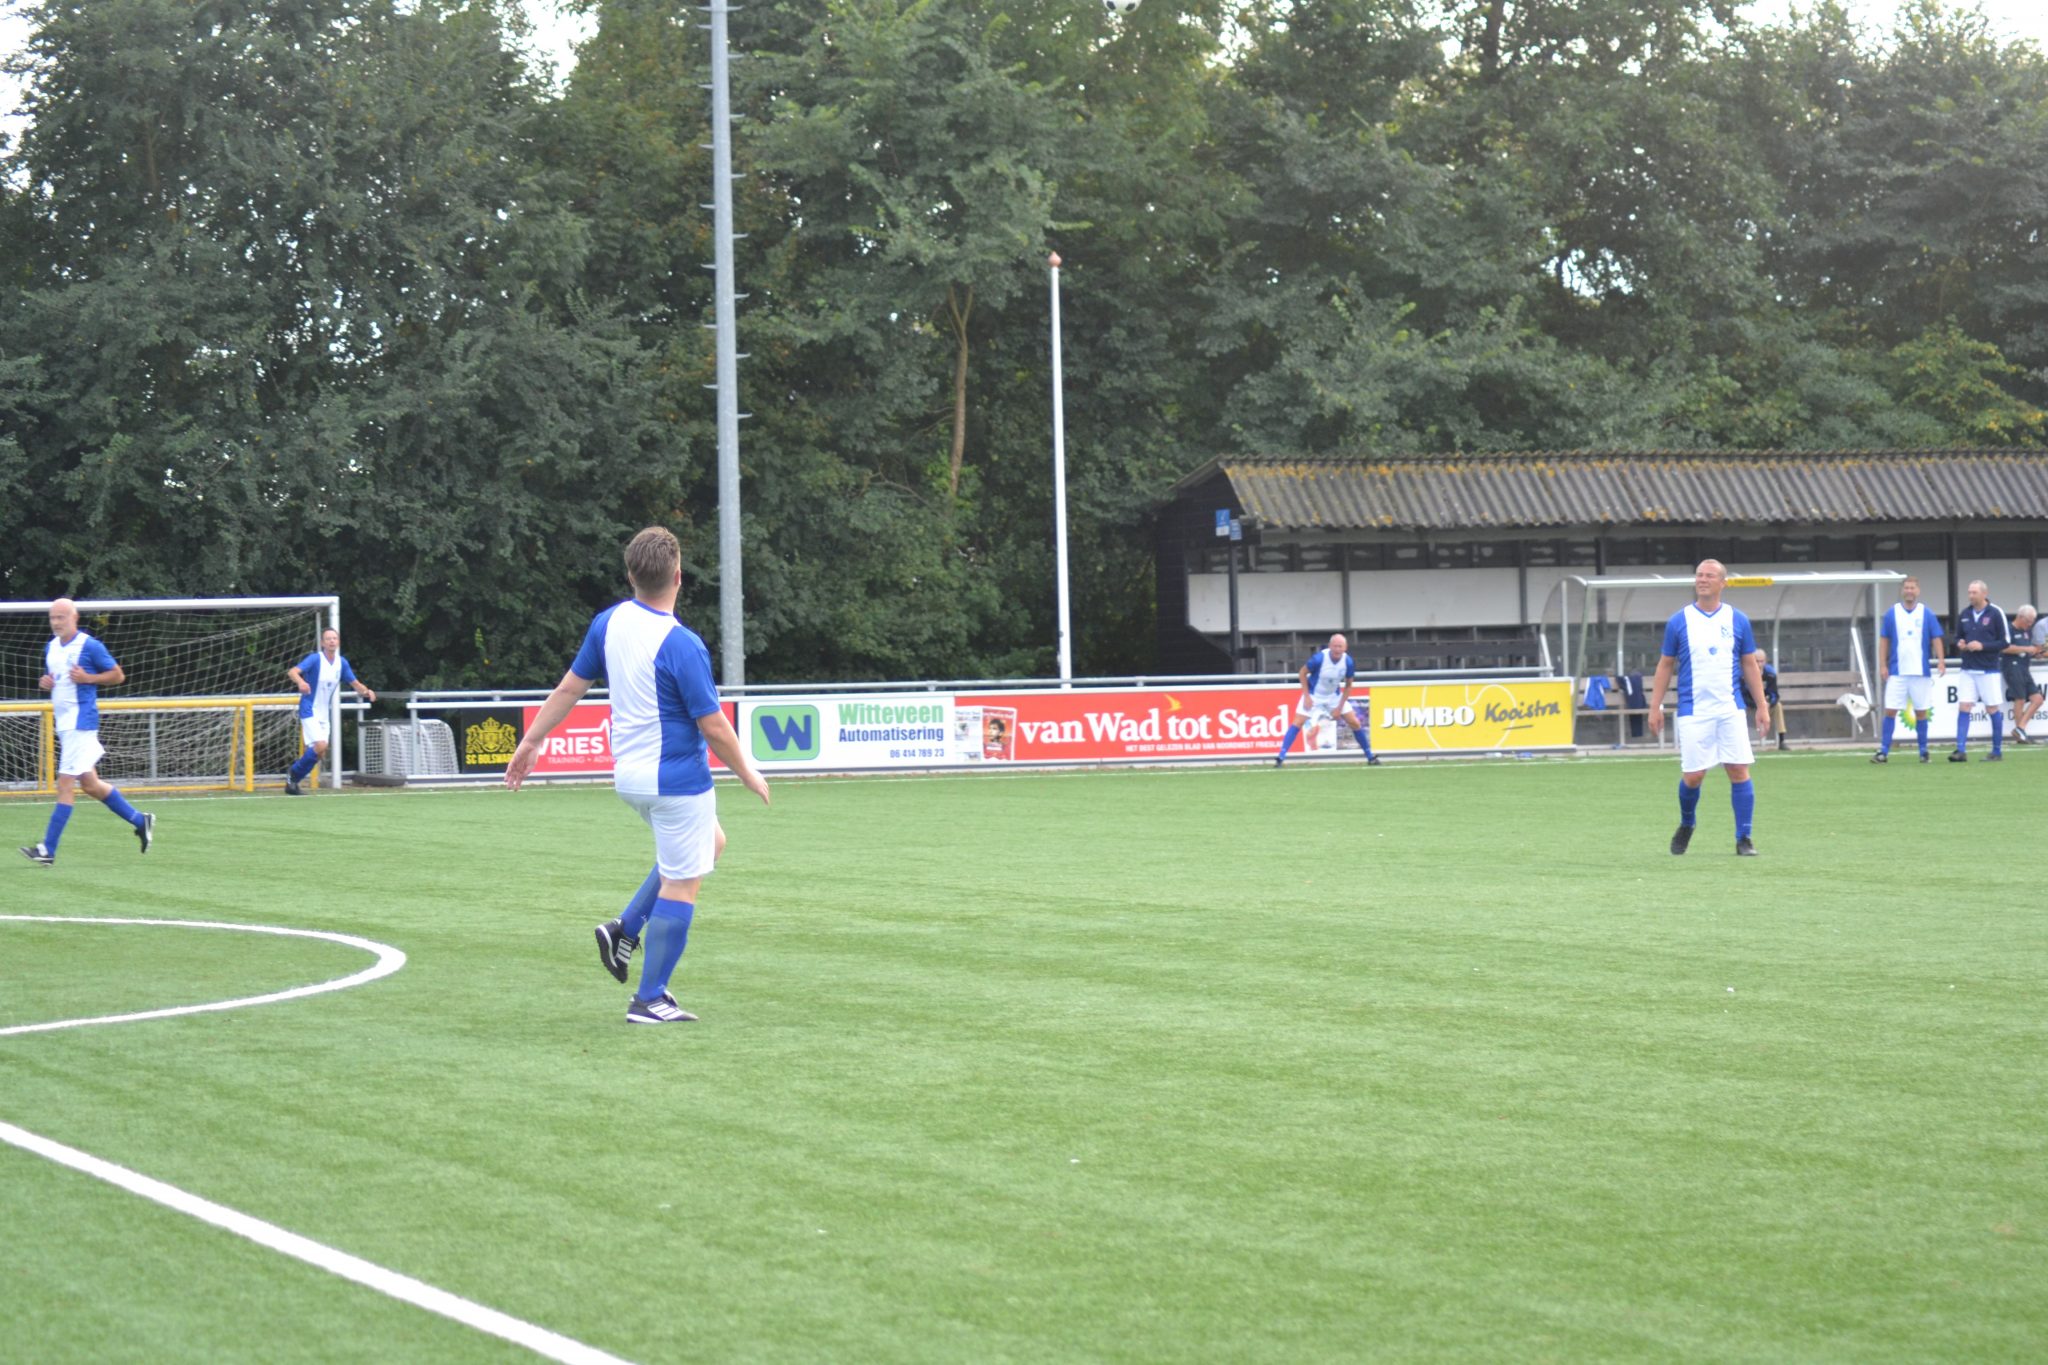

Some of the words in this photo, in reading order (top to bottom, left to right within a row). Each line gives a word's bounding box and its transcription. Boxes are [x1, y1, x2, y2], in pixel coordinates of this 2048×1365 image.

[838, 703, 944, 726] Witteveen
[1019, 721, 1086, 744] van
[1084, 707, 1162, 742] Wad
[1167, 714, 1212, 740] tot
[1218, 703, 1290, 739] Stad
[1381, 705, 1475, 728] JUMBO
[1484, 700, 1560, 722] Kooistra
[1968, 709, 1988, 721] ank
[759, 714, 812, 750] W
[838, 726, 944, 742] Automatisering
